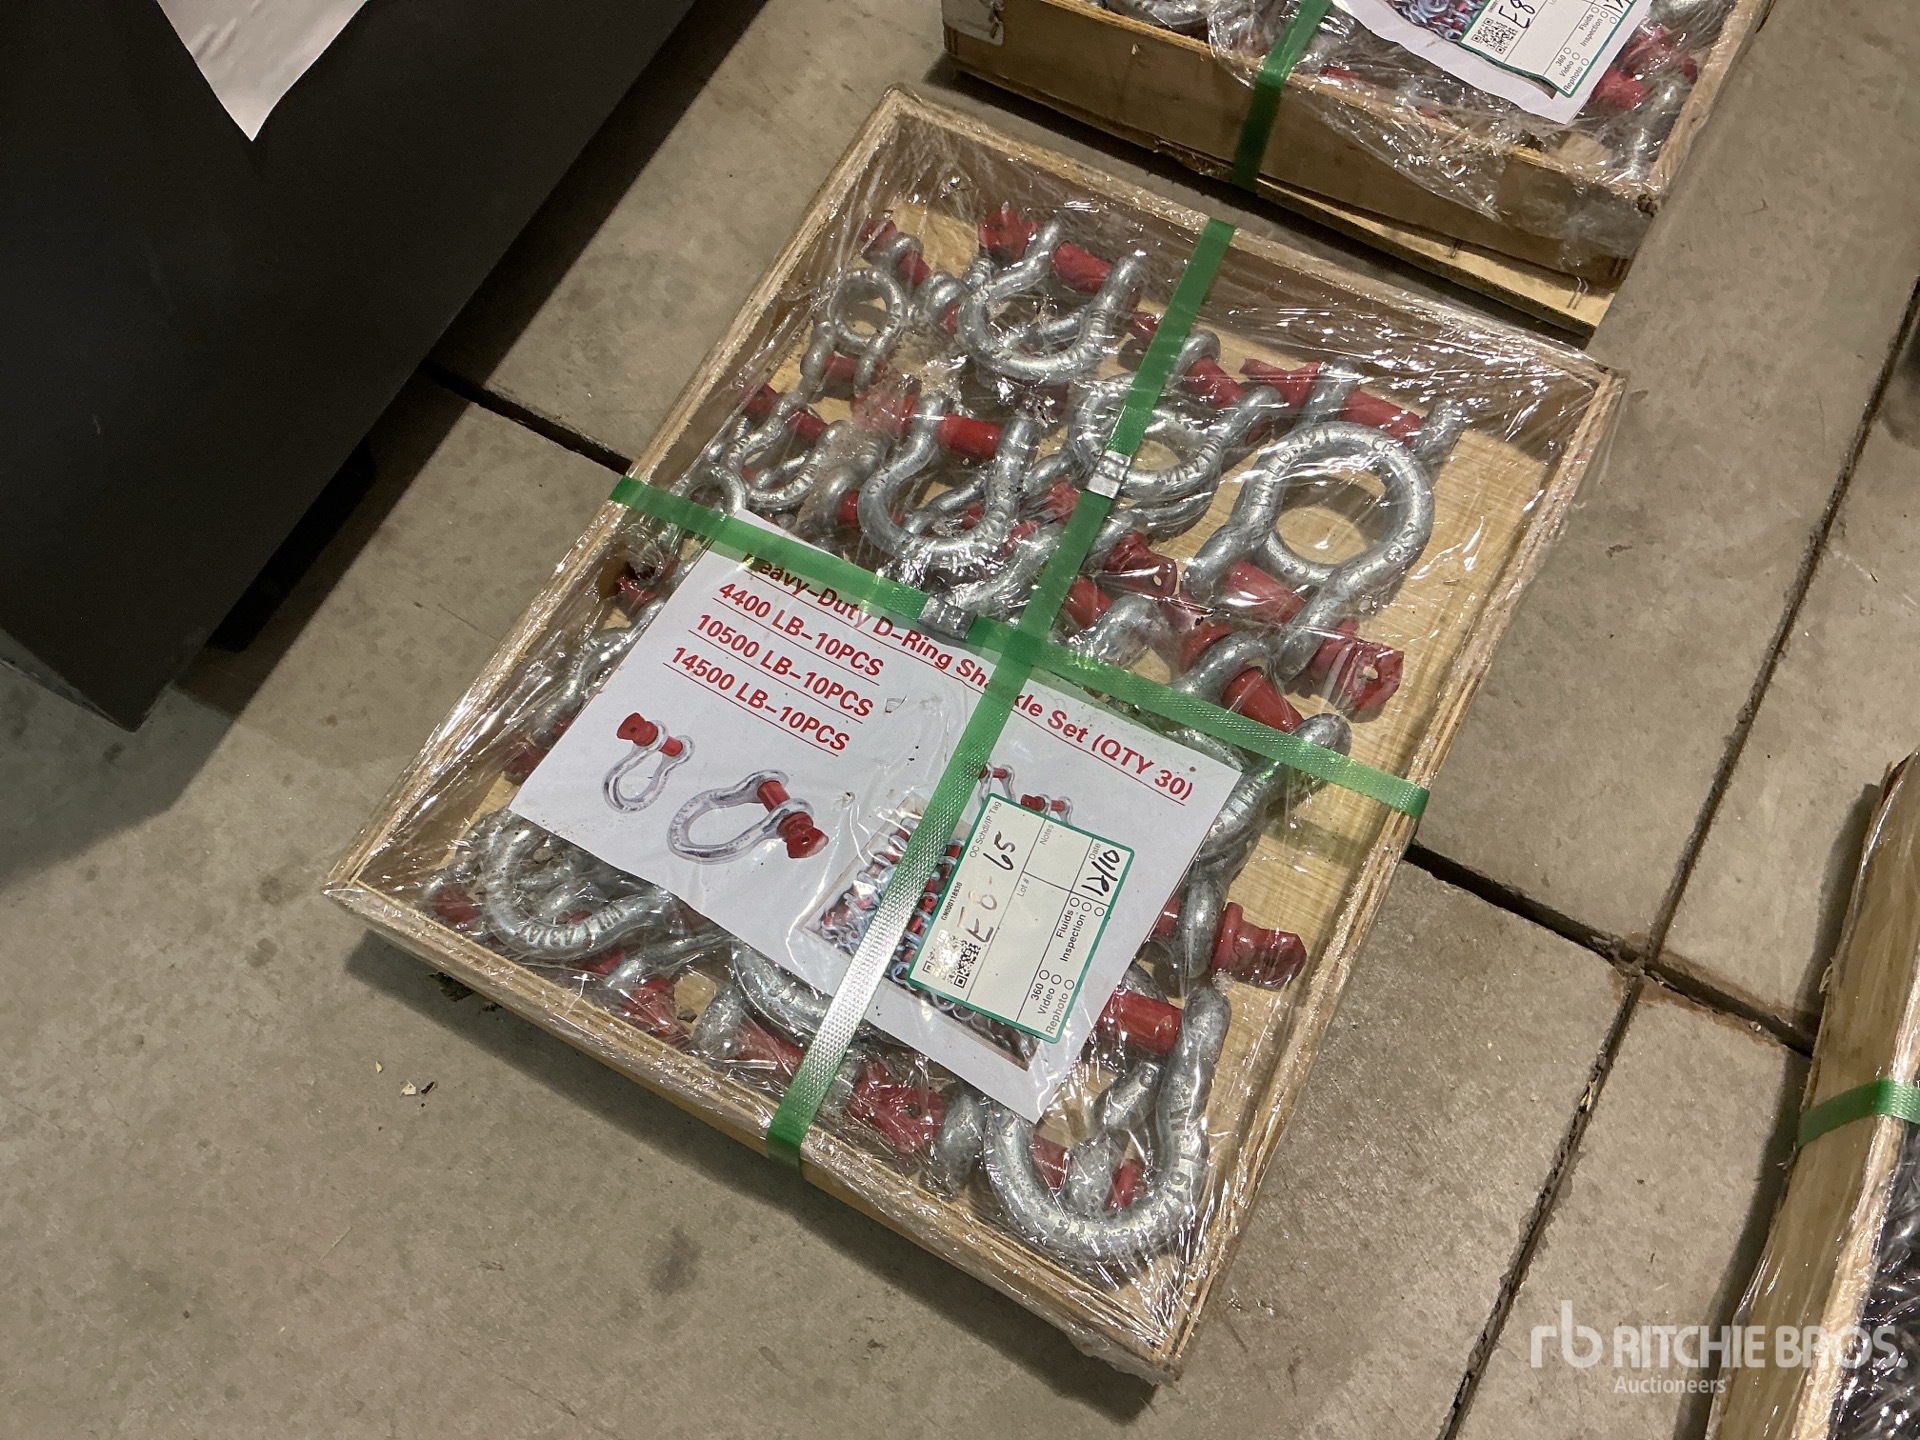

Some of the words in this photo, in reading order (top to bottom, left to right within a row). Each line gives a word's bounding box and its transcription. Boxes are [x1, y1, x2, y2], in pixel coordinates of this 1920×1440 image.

[1578, 13, 1594, 32] Fluids
[1580, 18, 1603, 47] Inspection
[1555, 54, 1567, 67] 360
[1559, 61, 1574, 77] Video
[1563, 66, 1584, 92] Rephoto
[718, 583, 771, 618] 4400
[771, 608, 884, 677] LB-10PCS
[696, 614, 760, 658] 10500
[759, 650, 874, 717] LB-10PCS
[741, 552, 871, 628] eavy-Duty
[872, 616, 953, 671] D-Ring
[955, 657, 1043, 717] Shkle
[1047, 709, 1089, 744] Set
[1091, 733, 1155, 775] (QTY
[1154, 769, 1194, 801] 30)
[671, 647, 735, 691] 14500
[734, 682, 850, 751] LB-10PCS
[969, 842, 980, 858] OC
[988, 800, 1002, 815] Tag
[1039, 824, 1054, 846] Notes
[1088, 842, 1102, 861] Date
[1016, 885, 1028, 897] Lot
[1055, 909, 1074, 939] Fluids
[1059, 913, 1086, 962] Inspection
[1030, 983, 1044, 1001] 360
[1037, 987, 1055, 1015] Video
[1045, 992, 1069, 1035] Rephoto
